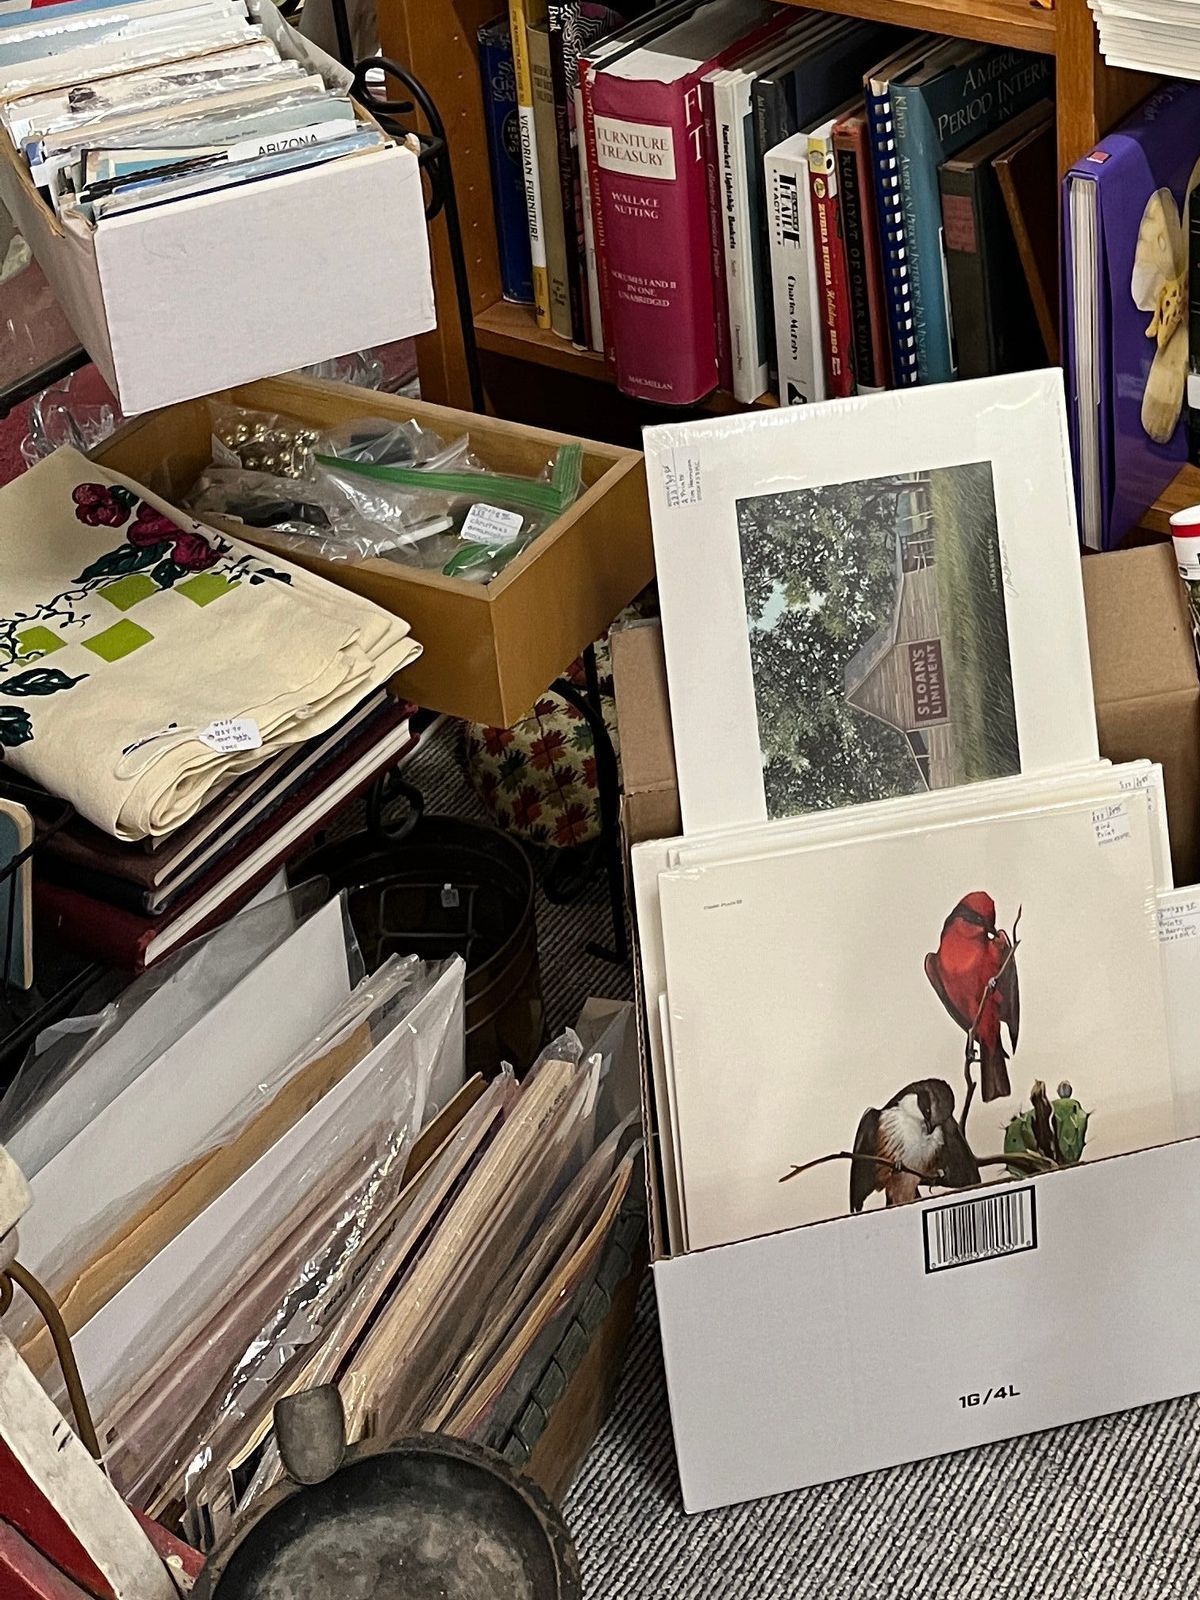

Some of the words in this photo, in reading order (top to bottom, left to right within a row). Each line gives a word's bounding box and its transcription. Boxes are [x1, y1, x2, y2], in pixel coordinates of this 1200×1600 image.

[936, 92, 993, 144] PERIOD
[258, 133, 320, 156] ARIZONA
[520, 114, 533, 176] VICTORIAN
[598, 127, 669, 152] FURNITURE
[722, 124, 731, 169] Nantucket
[600, 144, 665, 167] TREASURY
[611, 192, 660, 208] WALLACE
[724, 172, 733, 212] Lightship
[526, 177, 540, 242] FURNITURE
[614, 204, 659, 220] NUTTING
[728, 214, 736, 249] Baskets
[628, 284, 640, 294] IN
[640, 287, 656, 296] ONE
[649, 280, 669, 289] AND
[618, 291, 670, 307] UNABRIDGED
[628, 376, 673, 390] MACMILLAN
[912, 648, 931, 716] SLOAN'S
[926, 644, 944, 715] LINIMENT
[958, 1384, 1021, 1409] 1G/4L
